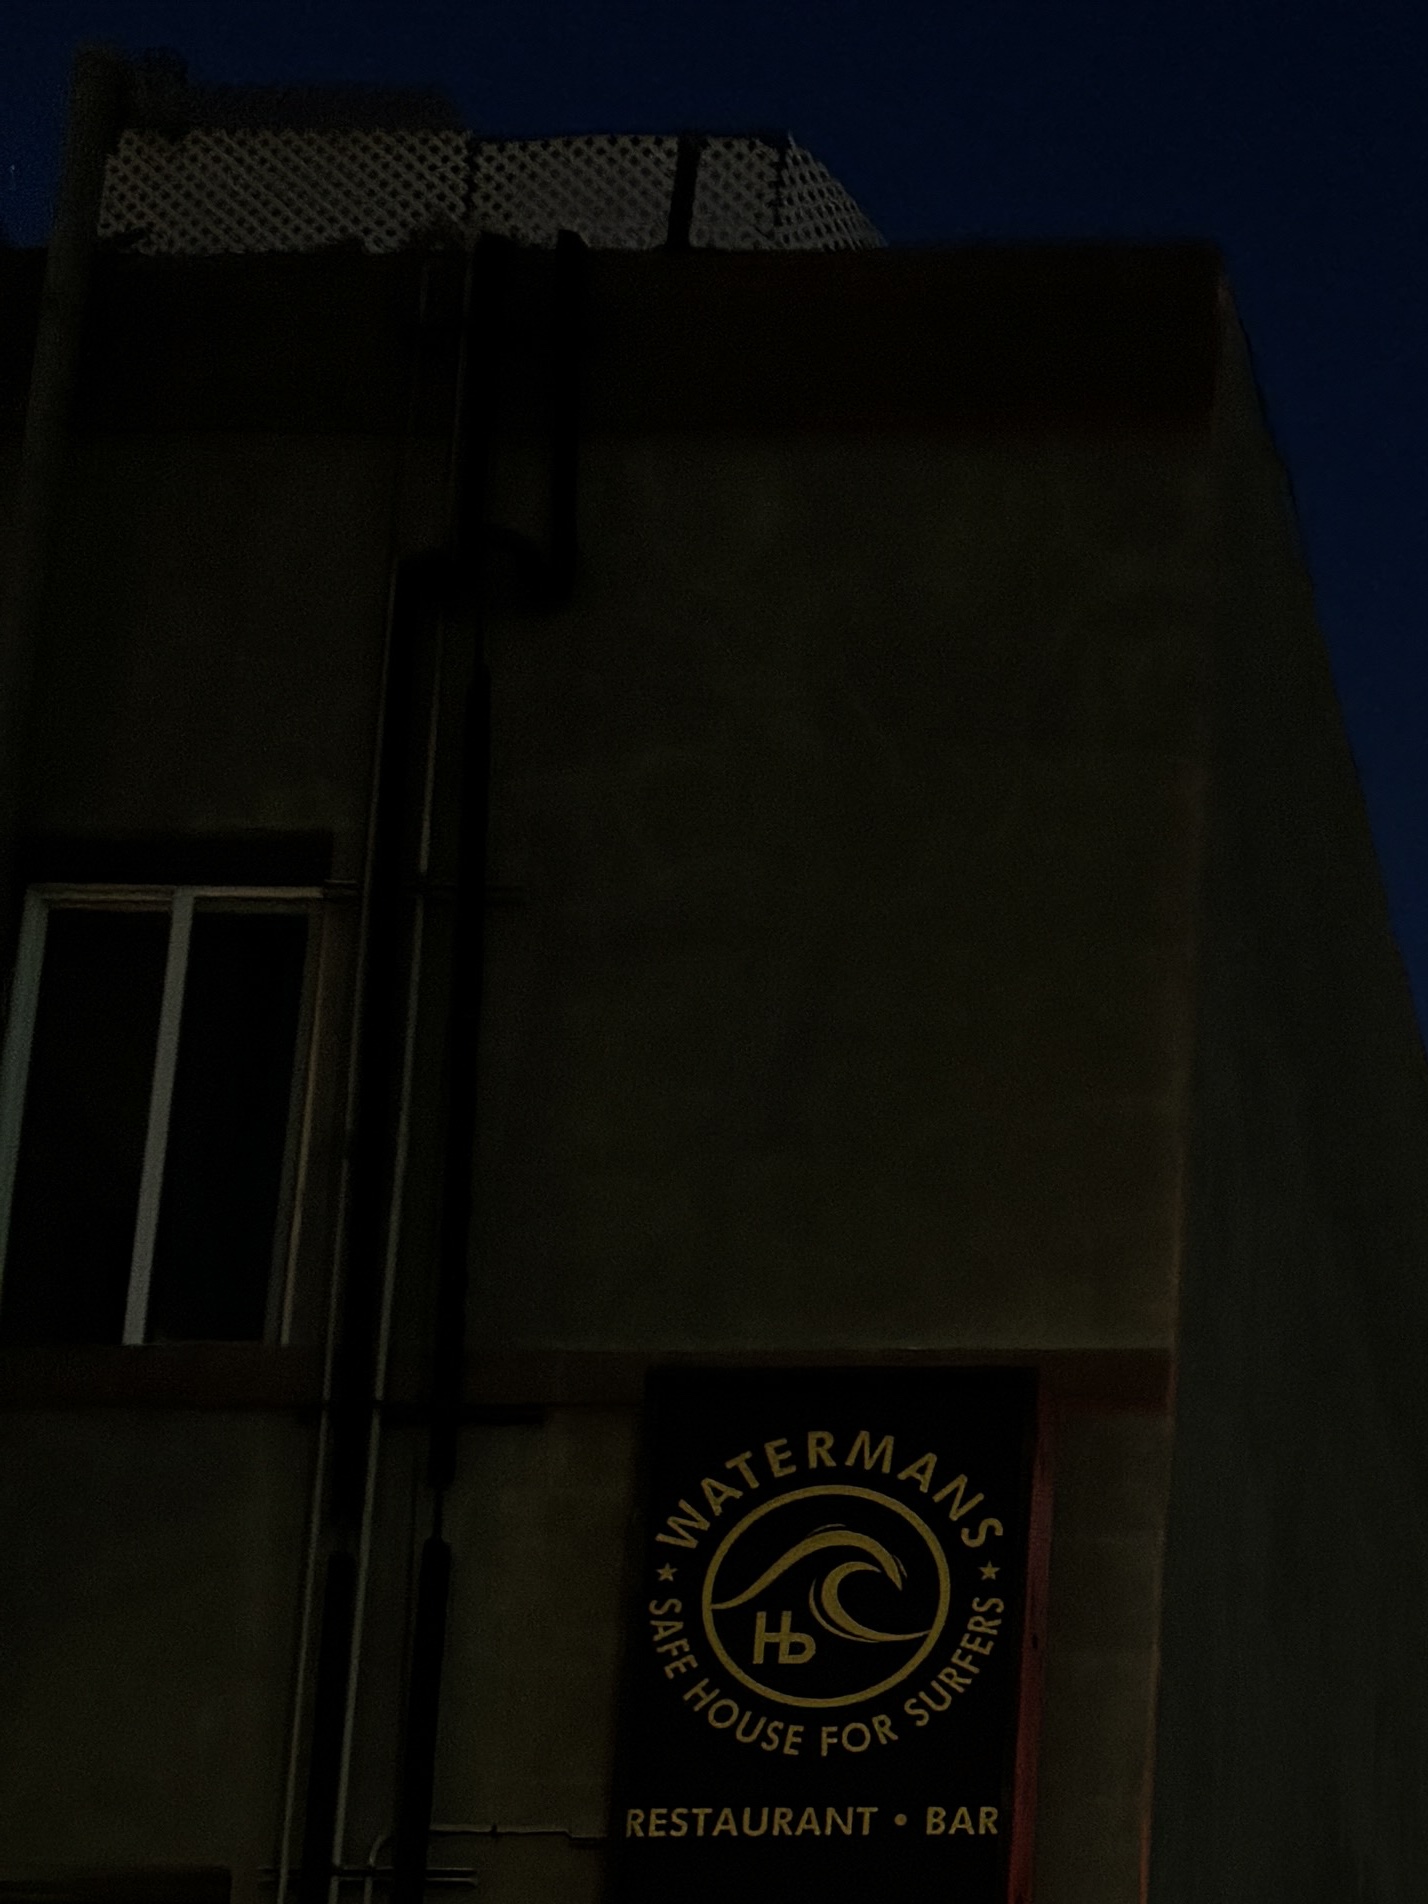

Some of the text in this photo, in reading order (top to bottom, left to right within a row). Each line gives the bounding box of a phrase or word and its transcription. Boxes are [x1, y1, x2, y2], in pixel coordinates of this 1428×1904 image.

[654, 1430, 1004, 1549] WATERMANS
[648, 1596, 1005, 1757] SAFE HOUSE FOR SURFERS
[625, 1805, 999, 1838] RESTAURANT BAR
